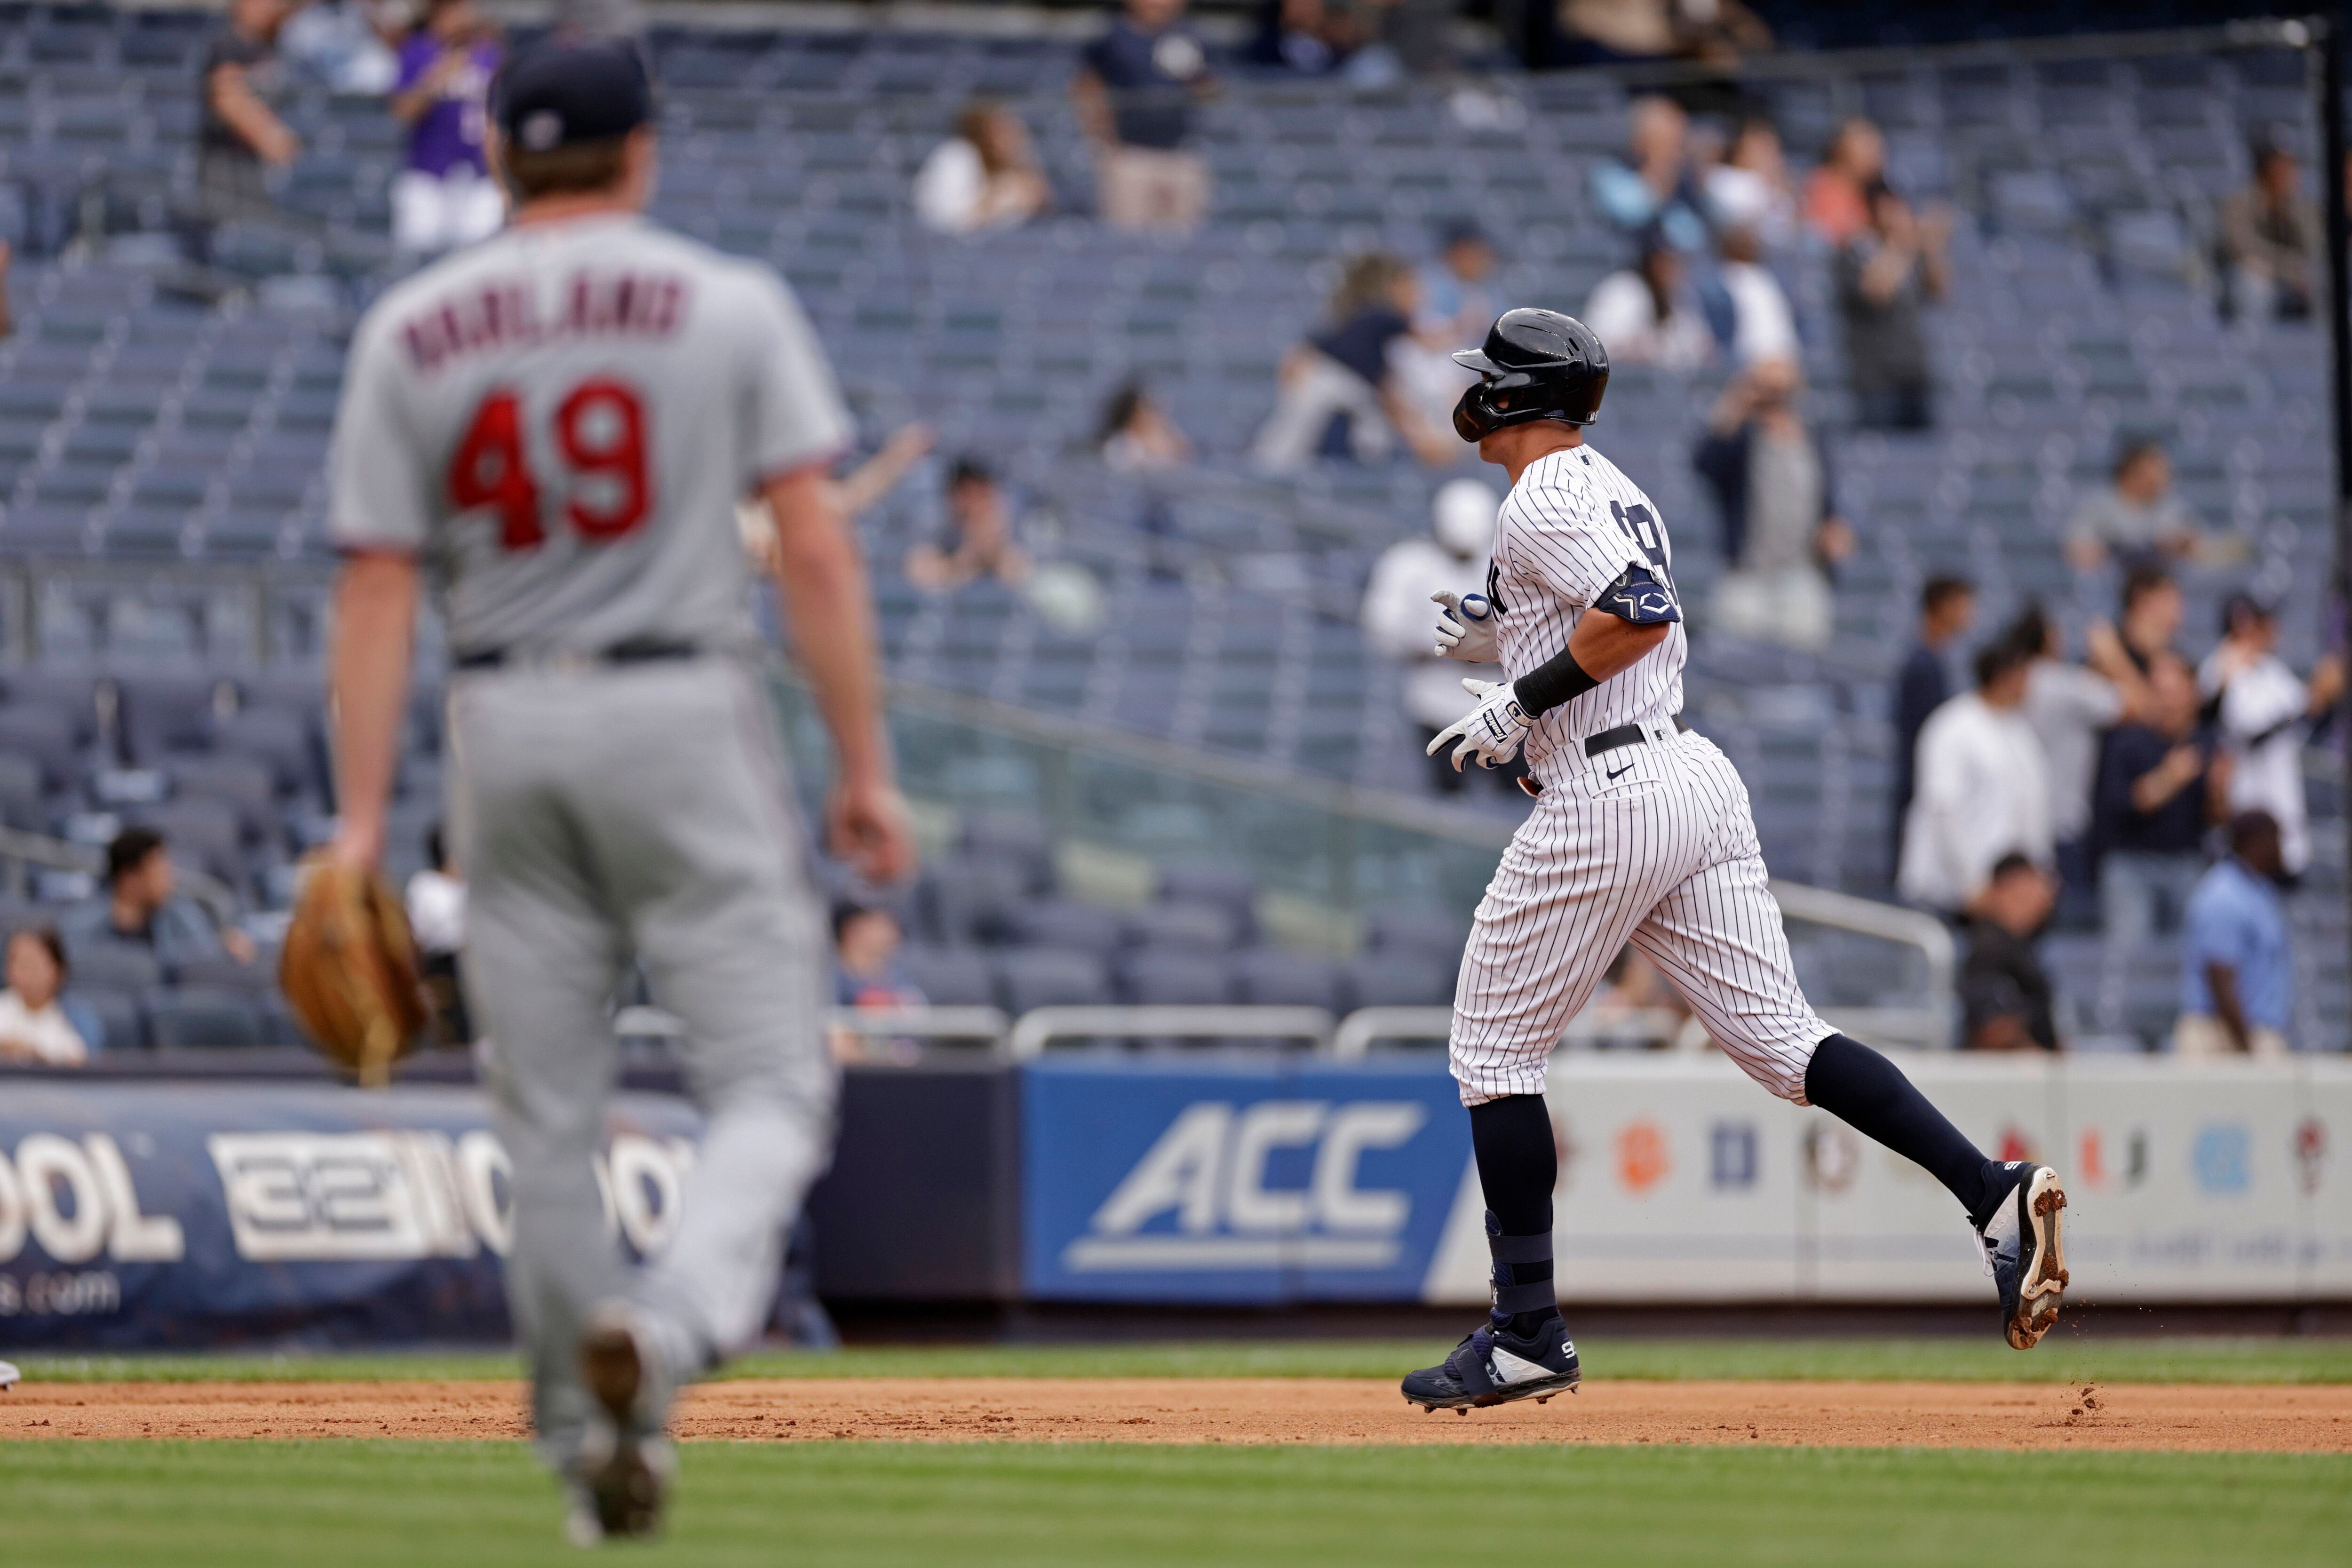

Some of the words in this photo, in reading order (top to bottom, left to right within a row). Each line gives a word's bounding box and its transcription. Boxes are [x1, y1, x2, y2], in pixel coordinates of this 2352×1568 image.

[449, 374, 649, 548] 49
[235, 1155, 391, 1232] 32
[1091, 1099, 1426, 1234] ACC
